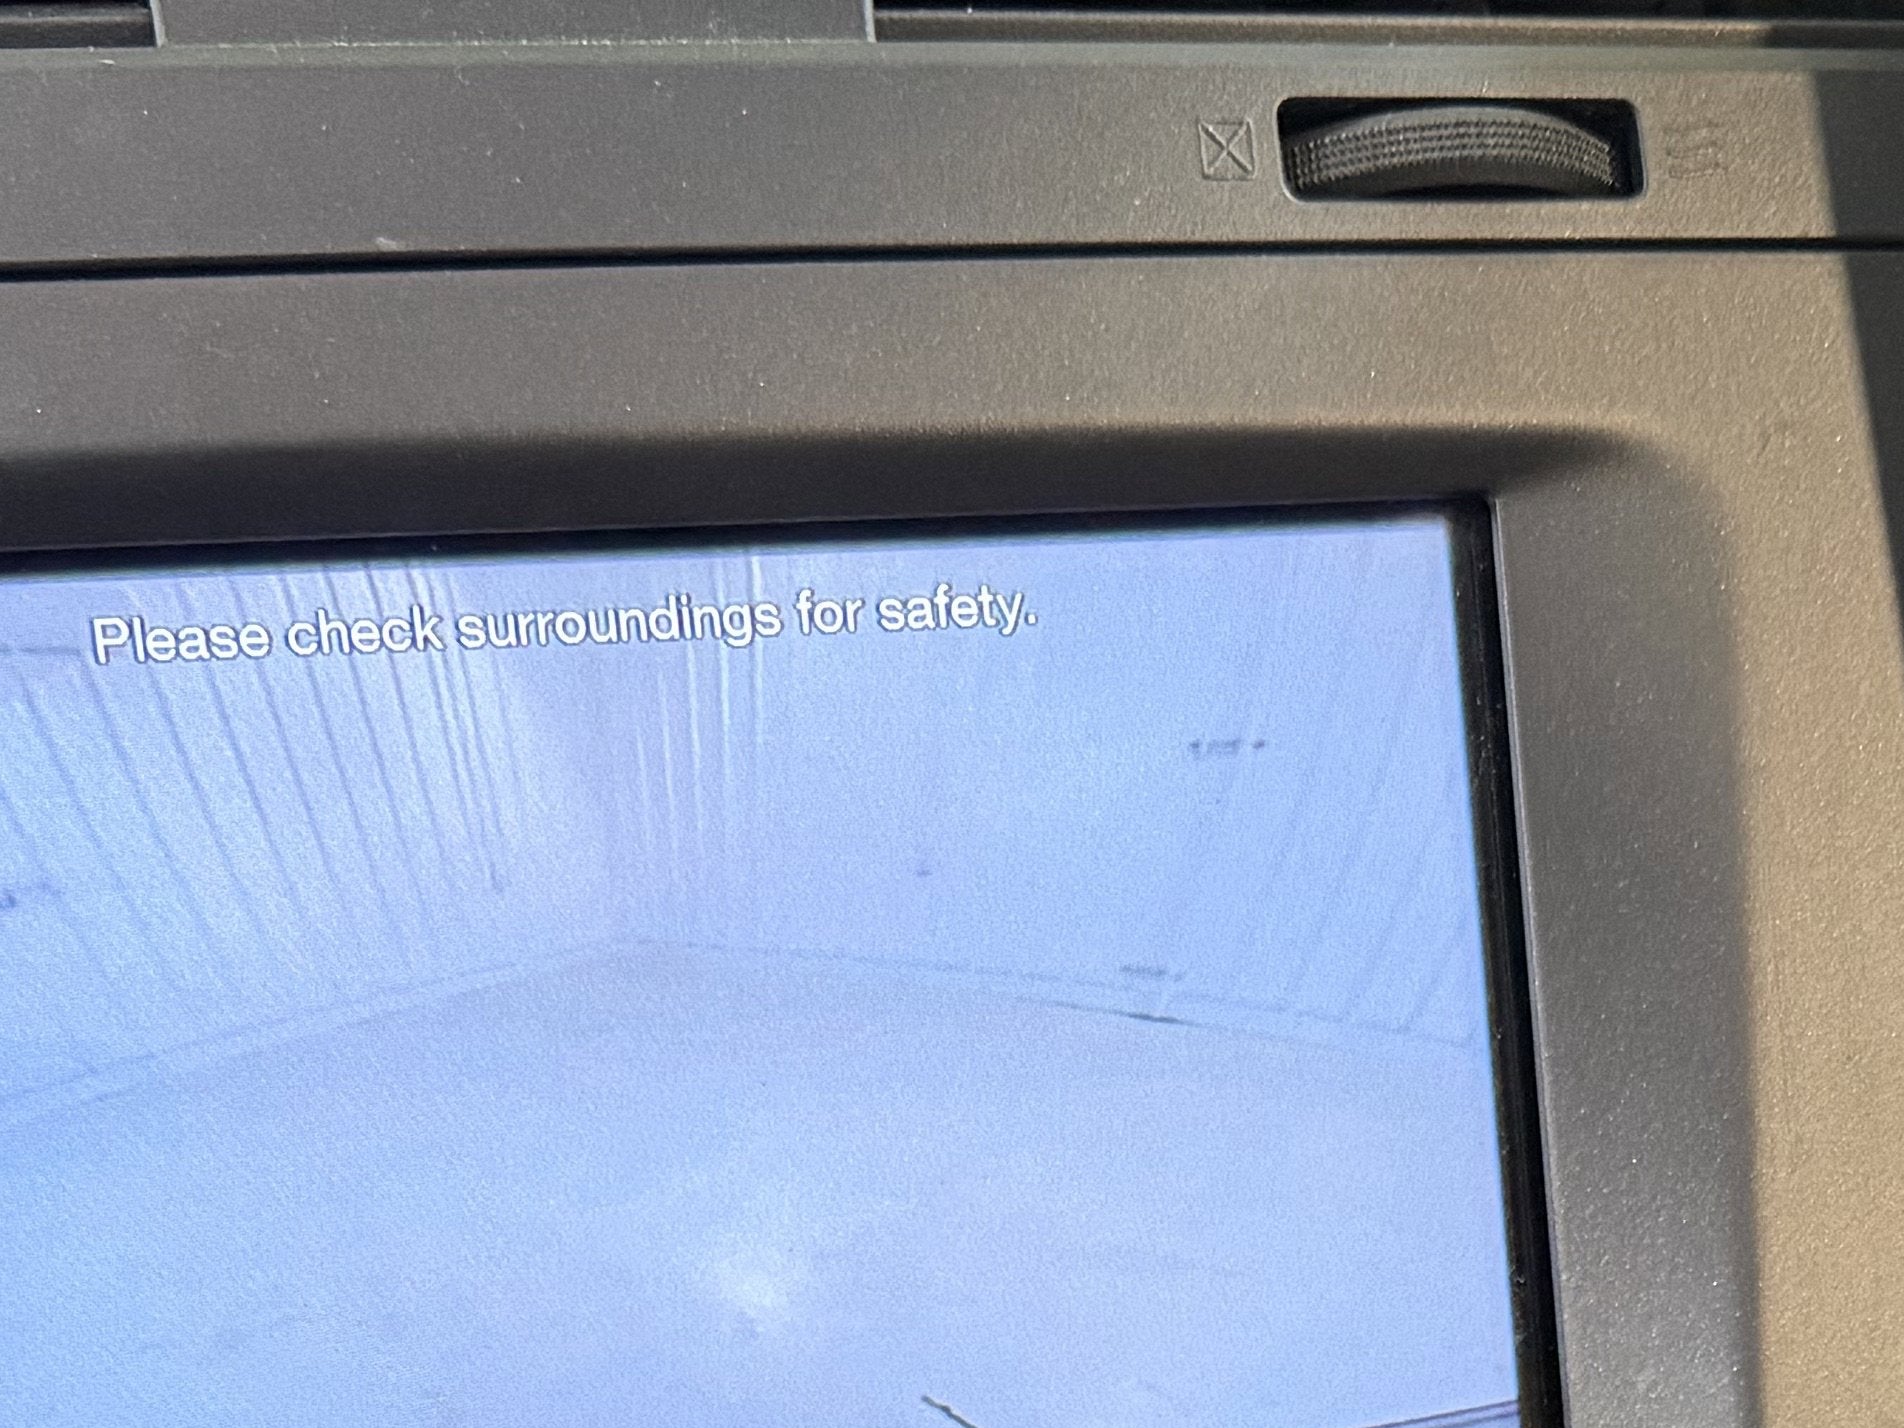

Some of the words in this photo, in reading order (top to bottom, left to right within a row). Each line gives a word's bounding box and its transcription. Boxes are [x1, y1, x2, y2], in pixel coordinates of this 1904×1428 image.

[92, 614, 273, 666] Please
[284, 605, 446, 657] check
[455, 594, 782, 651] surroundings
[796, 588, 864, 635] for
[877, 585, 1039, 637] safety.
